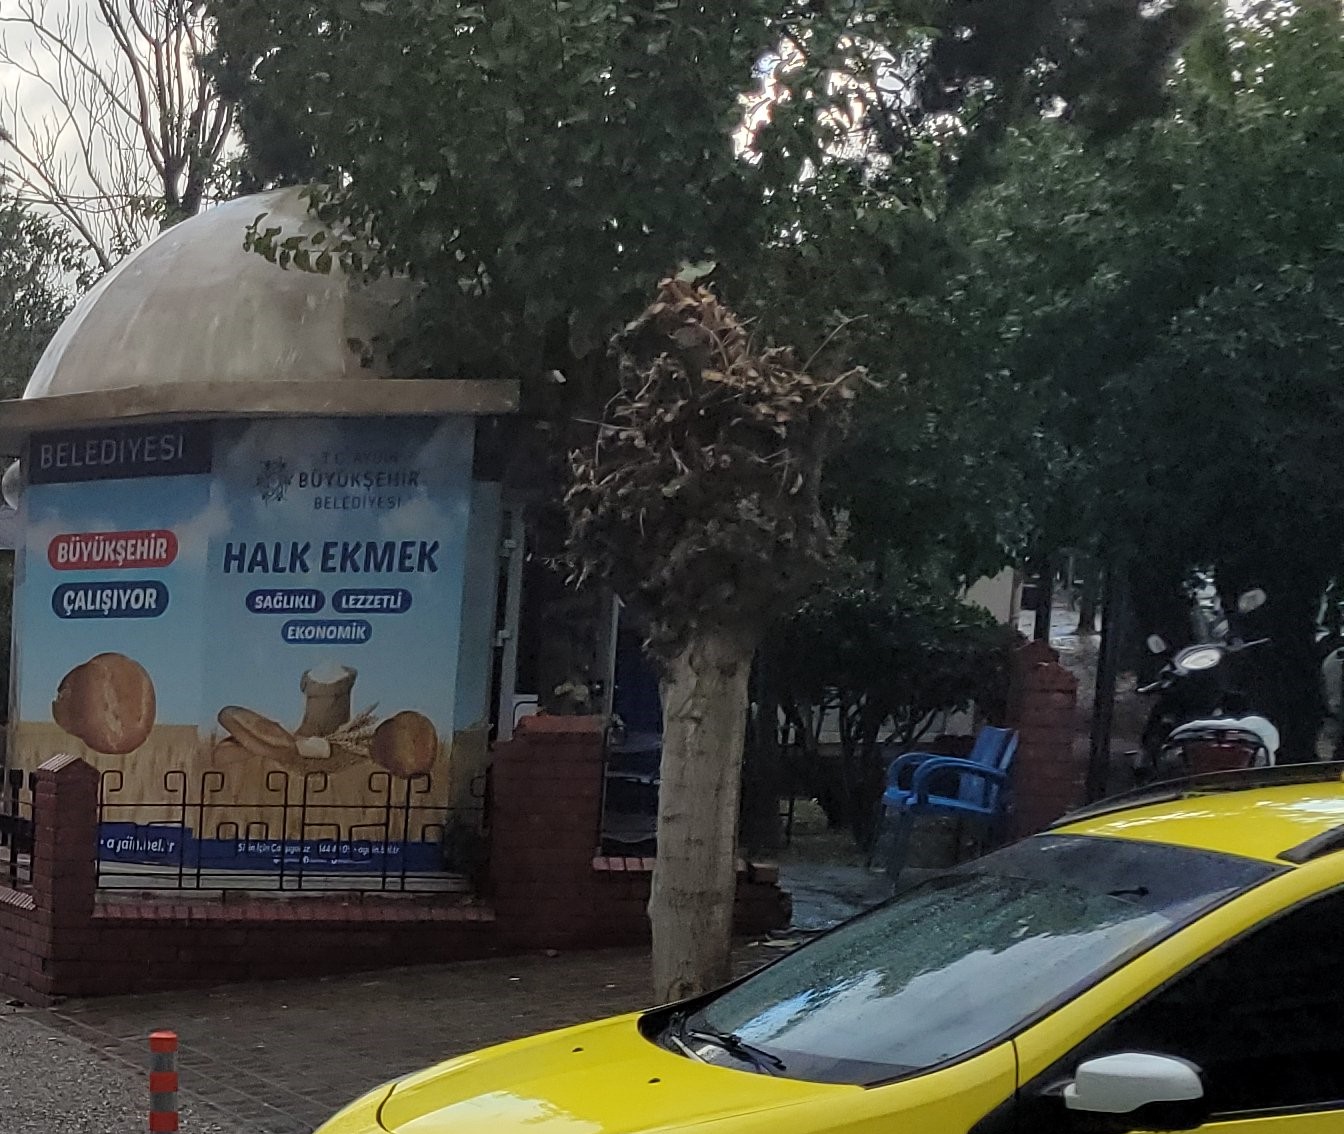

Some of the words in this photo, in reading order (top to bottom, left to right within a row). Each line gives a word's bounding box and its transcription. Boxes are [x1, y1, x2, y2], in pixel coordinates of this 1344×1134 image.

[57, 533, 168, 567] BÜYÜKŞEHİR
[223, 541, 311, 573] HALK
[320, 540, 440, 573] EKMEK
[63, 588, 157, 616] ÇALIŞIYOR
[255, 592, 316, 609] SAĞLIKLI
[342, 592, 403, 609] LEZZETLİ
[287, 622, 367, 640] EKONOMİK
